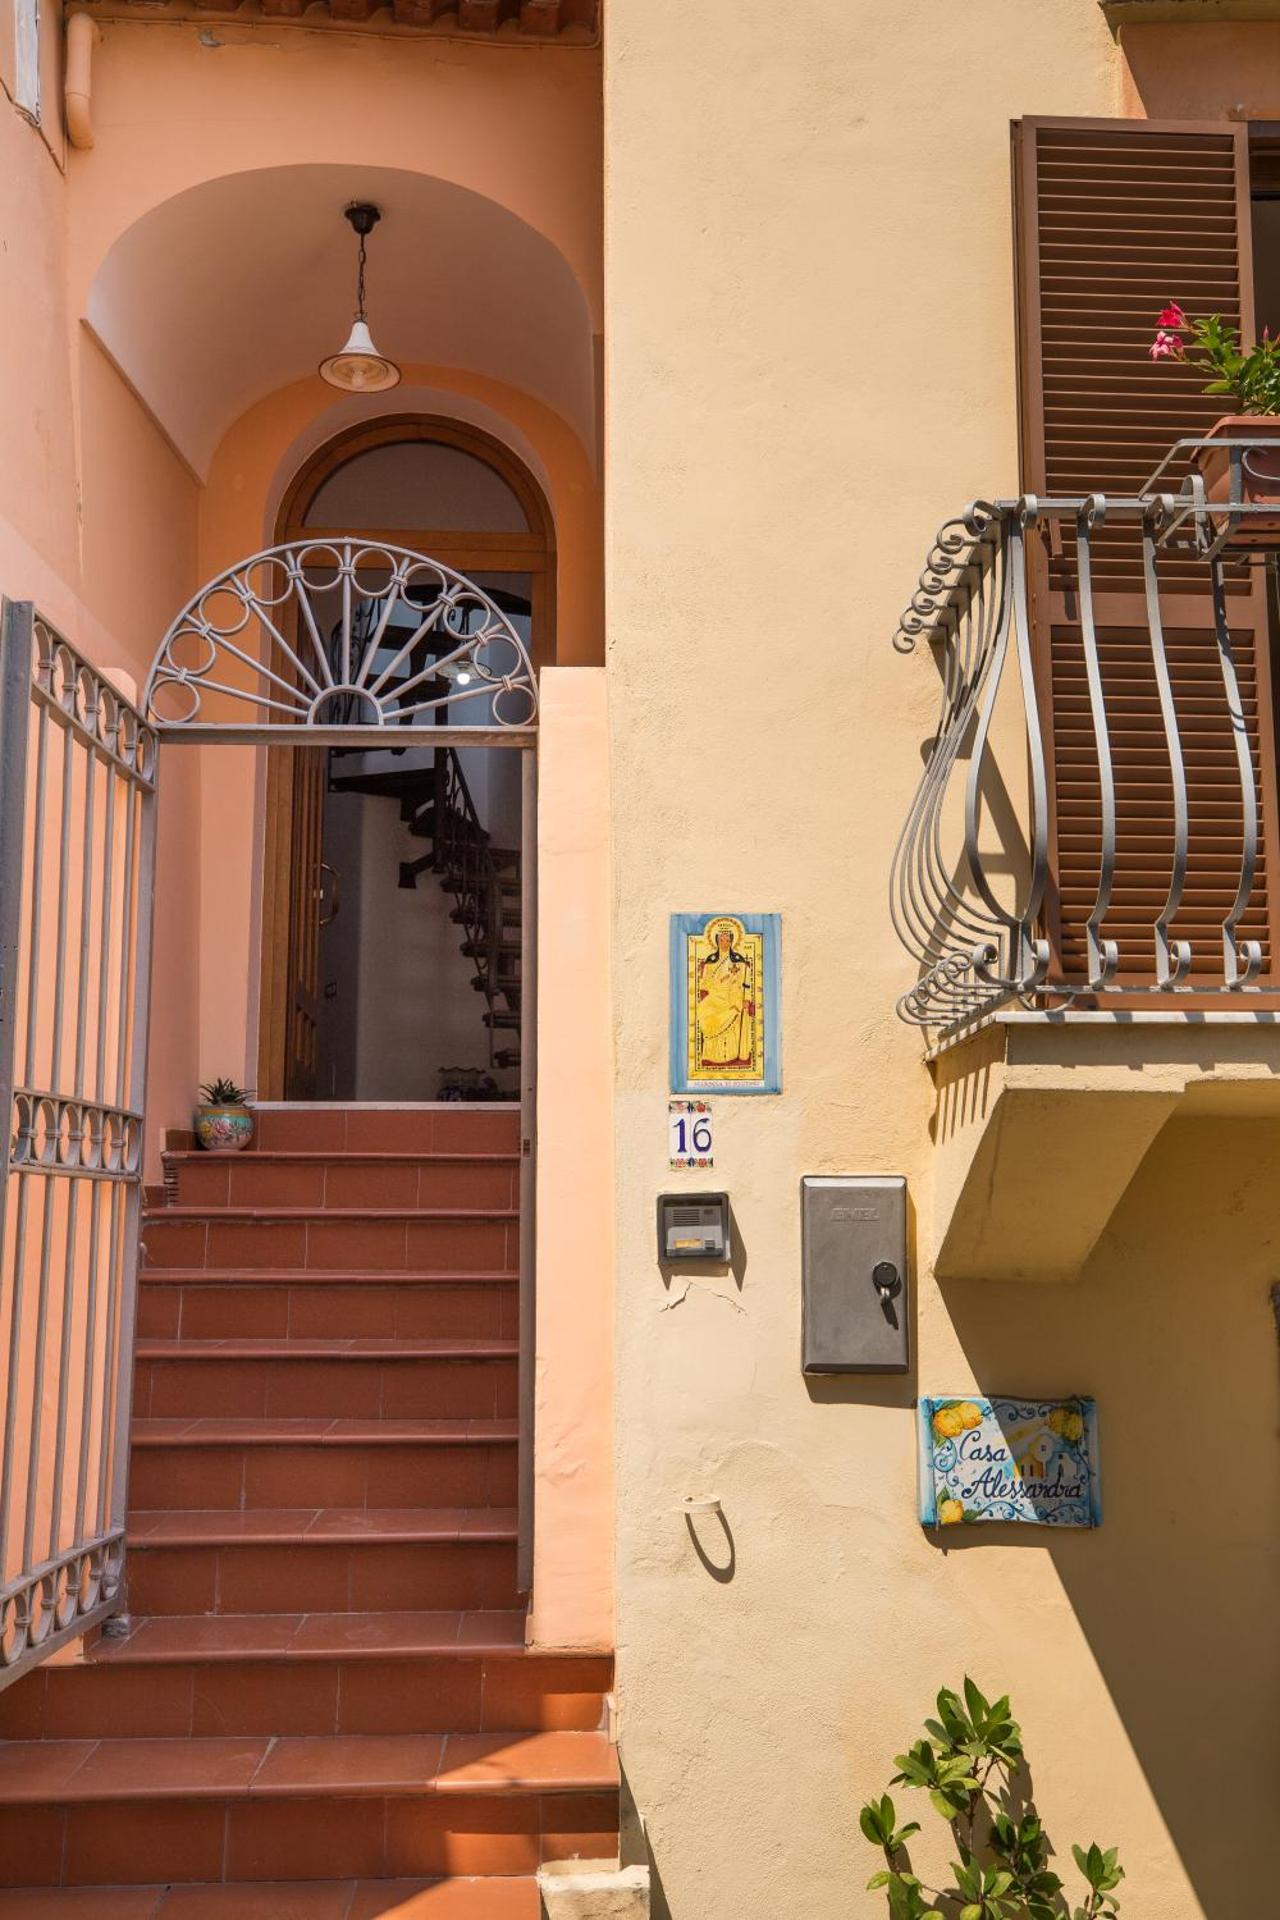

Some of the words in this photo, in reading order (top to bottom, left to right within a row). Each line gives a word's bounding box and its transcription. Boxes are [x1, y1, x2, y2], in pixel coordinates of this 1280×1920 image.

[672, 1118, 712, 1153] 16
[959, 1430, 1008, 1462] Casa
[961, 1465, 1083, 1499] Alessandra
